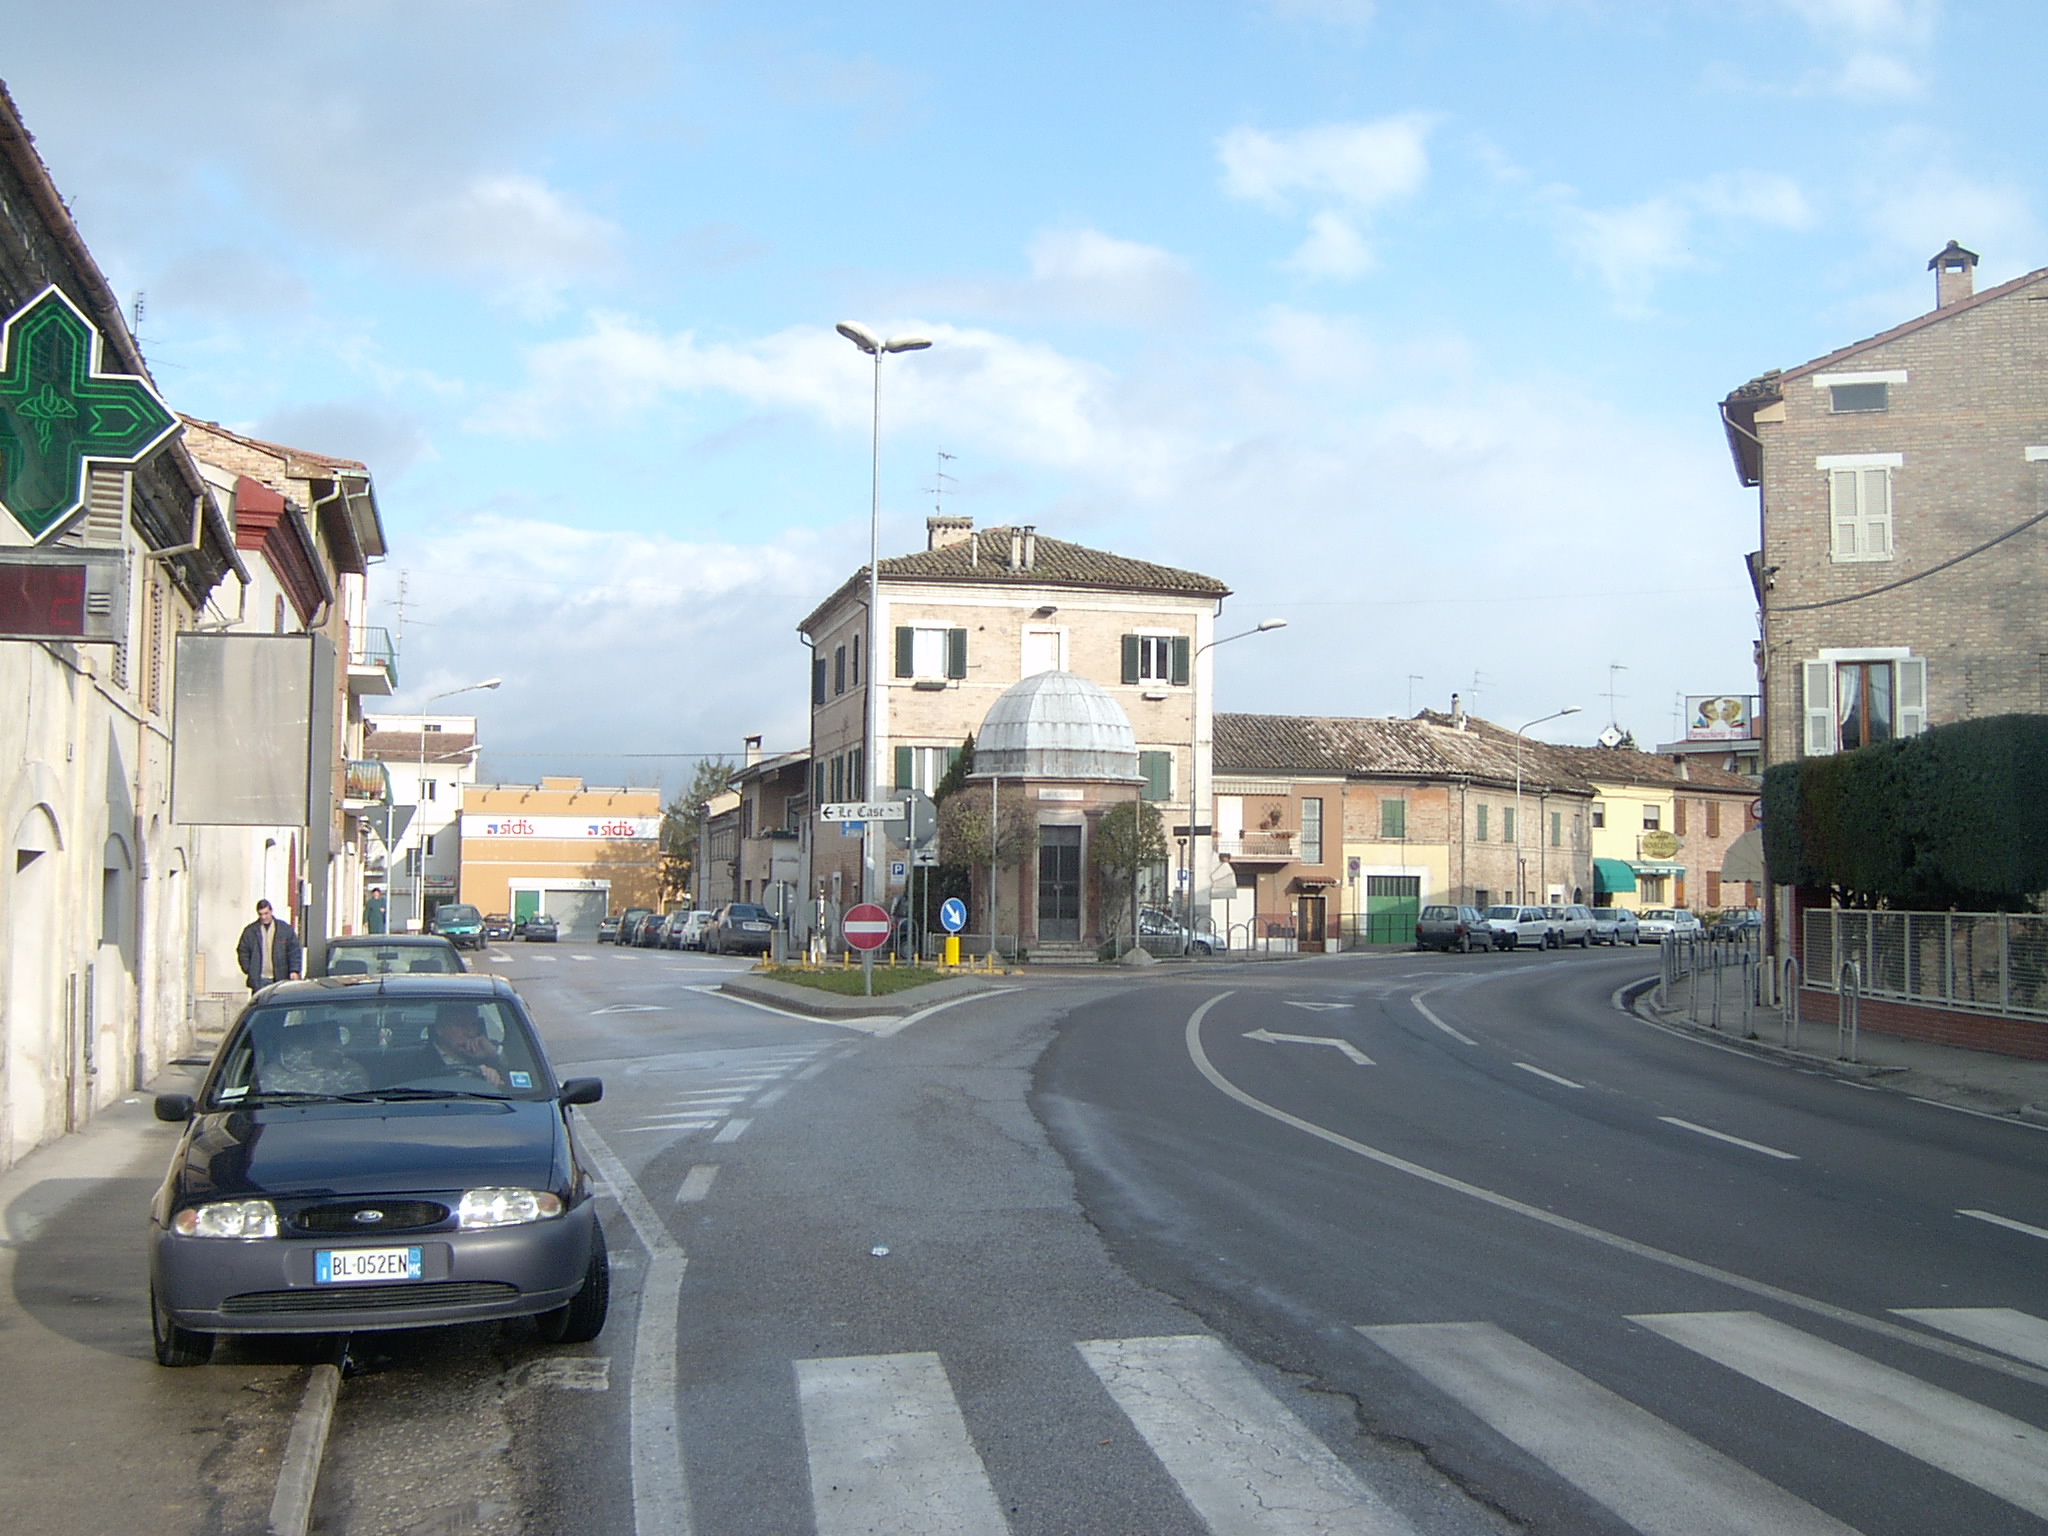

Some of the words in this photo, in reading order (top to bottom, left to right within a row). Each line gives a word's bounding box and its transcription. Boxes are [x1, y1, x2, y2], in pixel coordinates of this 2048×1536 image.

[837, 806, 852, 818] Le
[857, 805, 885, 818] Case
[500, 819, 534, 835] sidis
[600, 820, 636, 836] sidis
[895, 864, 903, 874] P
